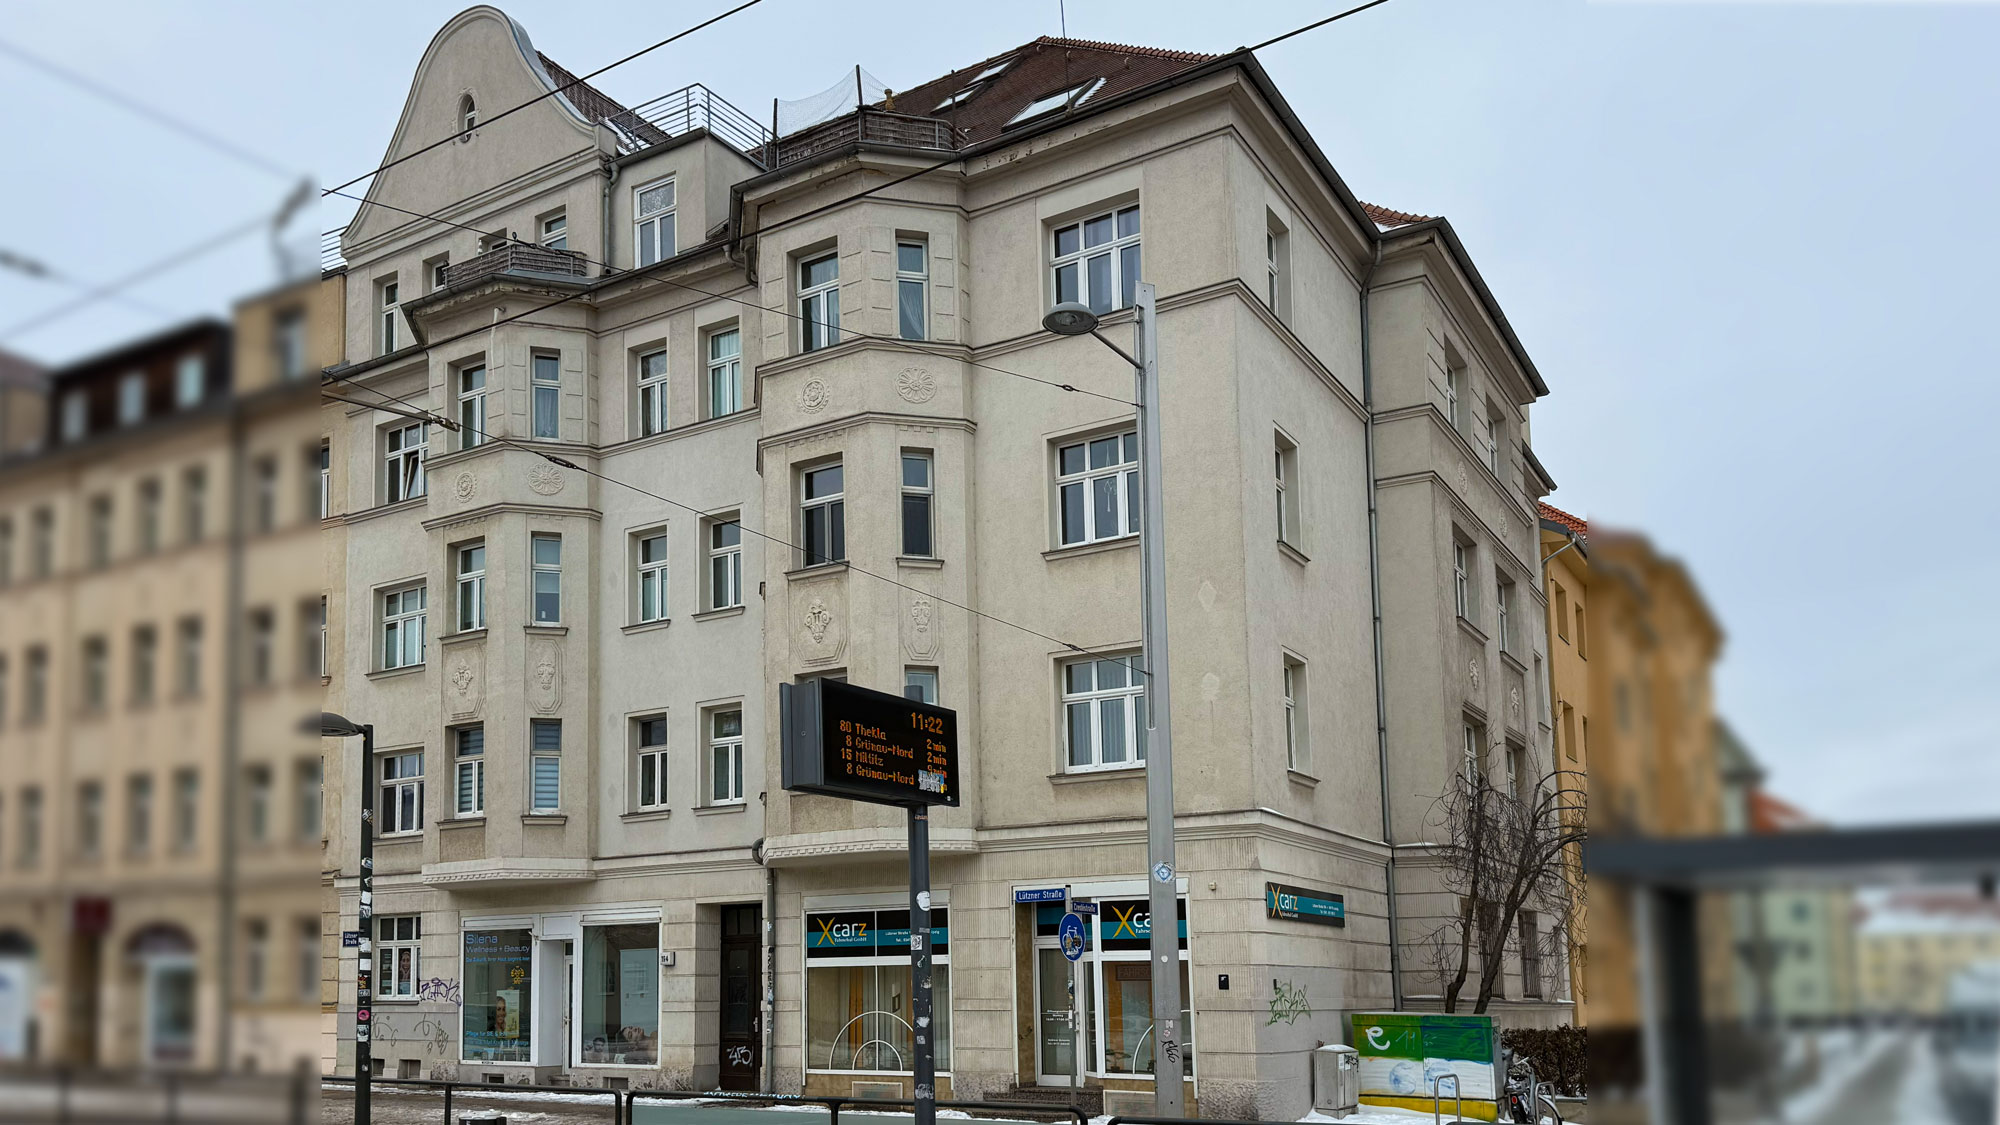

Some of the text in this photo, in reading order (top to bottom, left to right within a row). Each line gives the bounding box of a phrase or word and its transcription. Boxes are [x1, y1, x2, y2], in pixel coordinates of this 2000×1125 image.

[911, 712, 943, 734] 11:22
[840, 720, 946, 753] 80 Thekla 2 min
[840, 748, 852, 760] 15
[845, 735, 947, 765] 8 Grünau-Nord 2 min
[846, 763, 852, 774] 8
[855, 765, 914, 785] Grünau-Nord
[1018, 890, 1062, 900] Lützner Straße
[1270, 884, 1298, 919] Xcarz
[817, 917, 867, 946] Xcarz
[1112, 904, 1151, 939] Xca
[504, 944, 530, 953] Beauty
